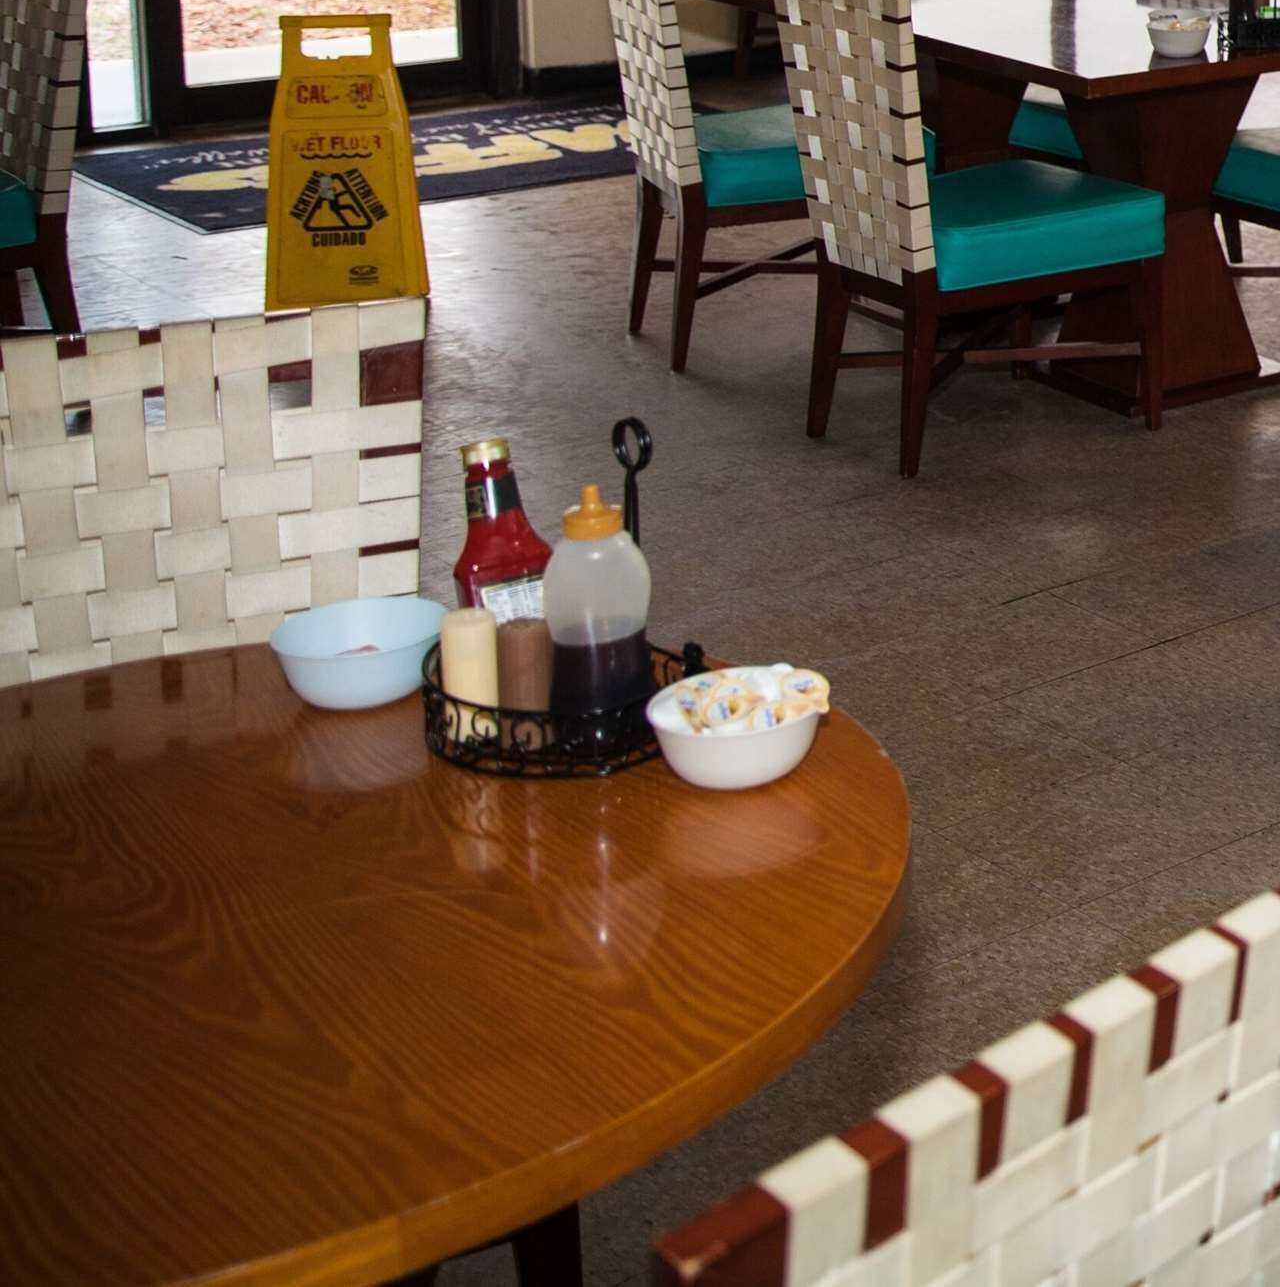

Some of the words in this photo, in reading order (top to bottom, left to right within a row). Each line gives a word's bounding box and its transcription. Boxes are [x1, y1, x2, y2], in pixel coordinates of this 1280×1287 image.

[292, 135, 325, 153] ET
[344, 168, 389, 222] ATTENTION
[312, 231, 366, 247] CUIDADO
